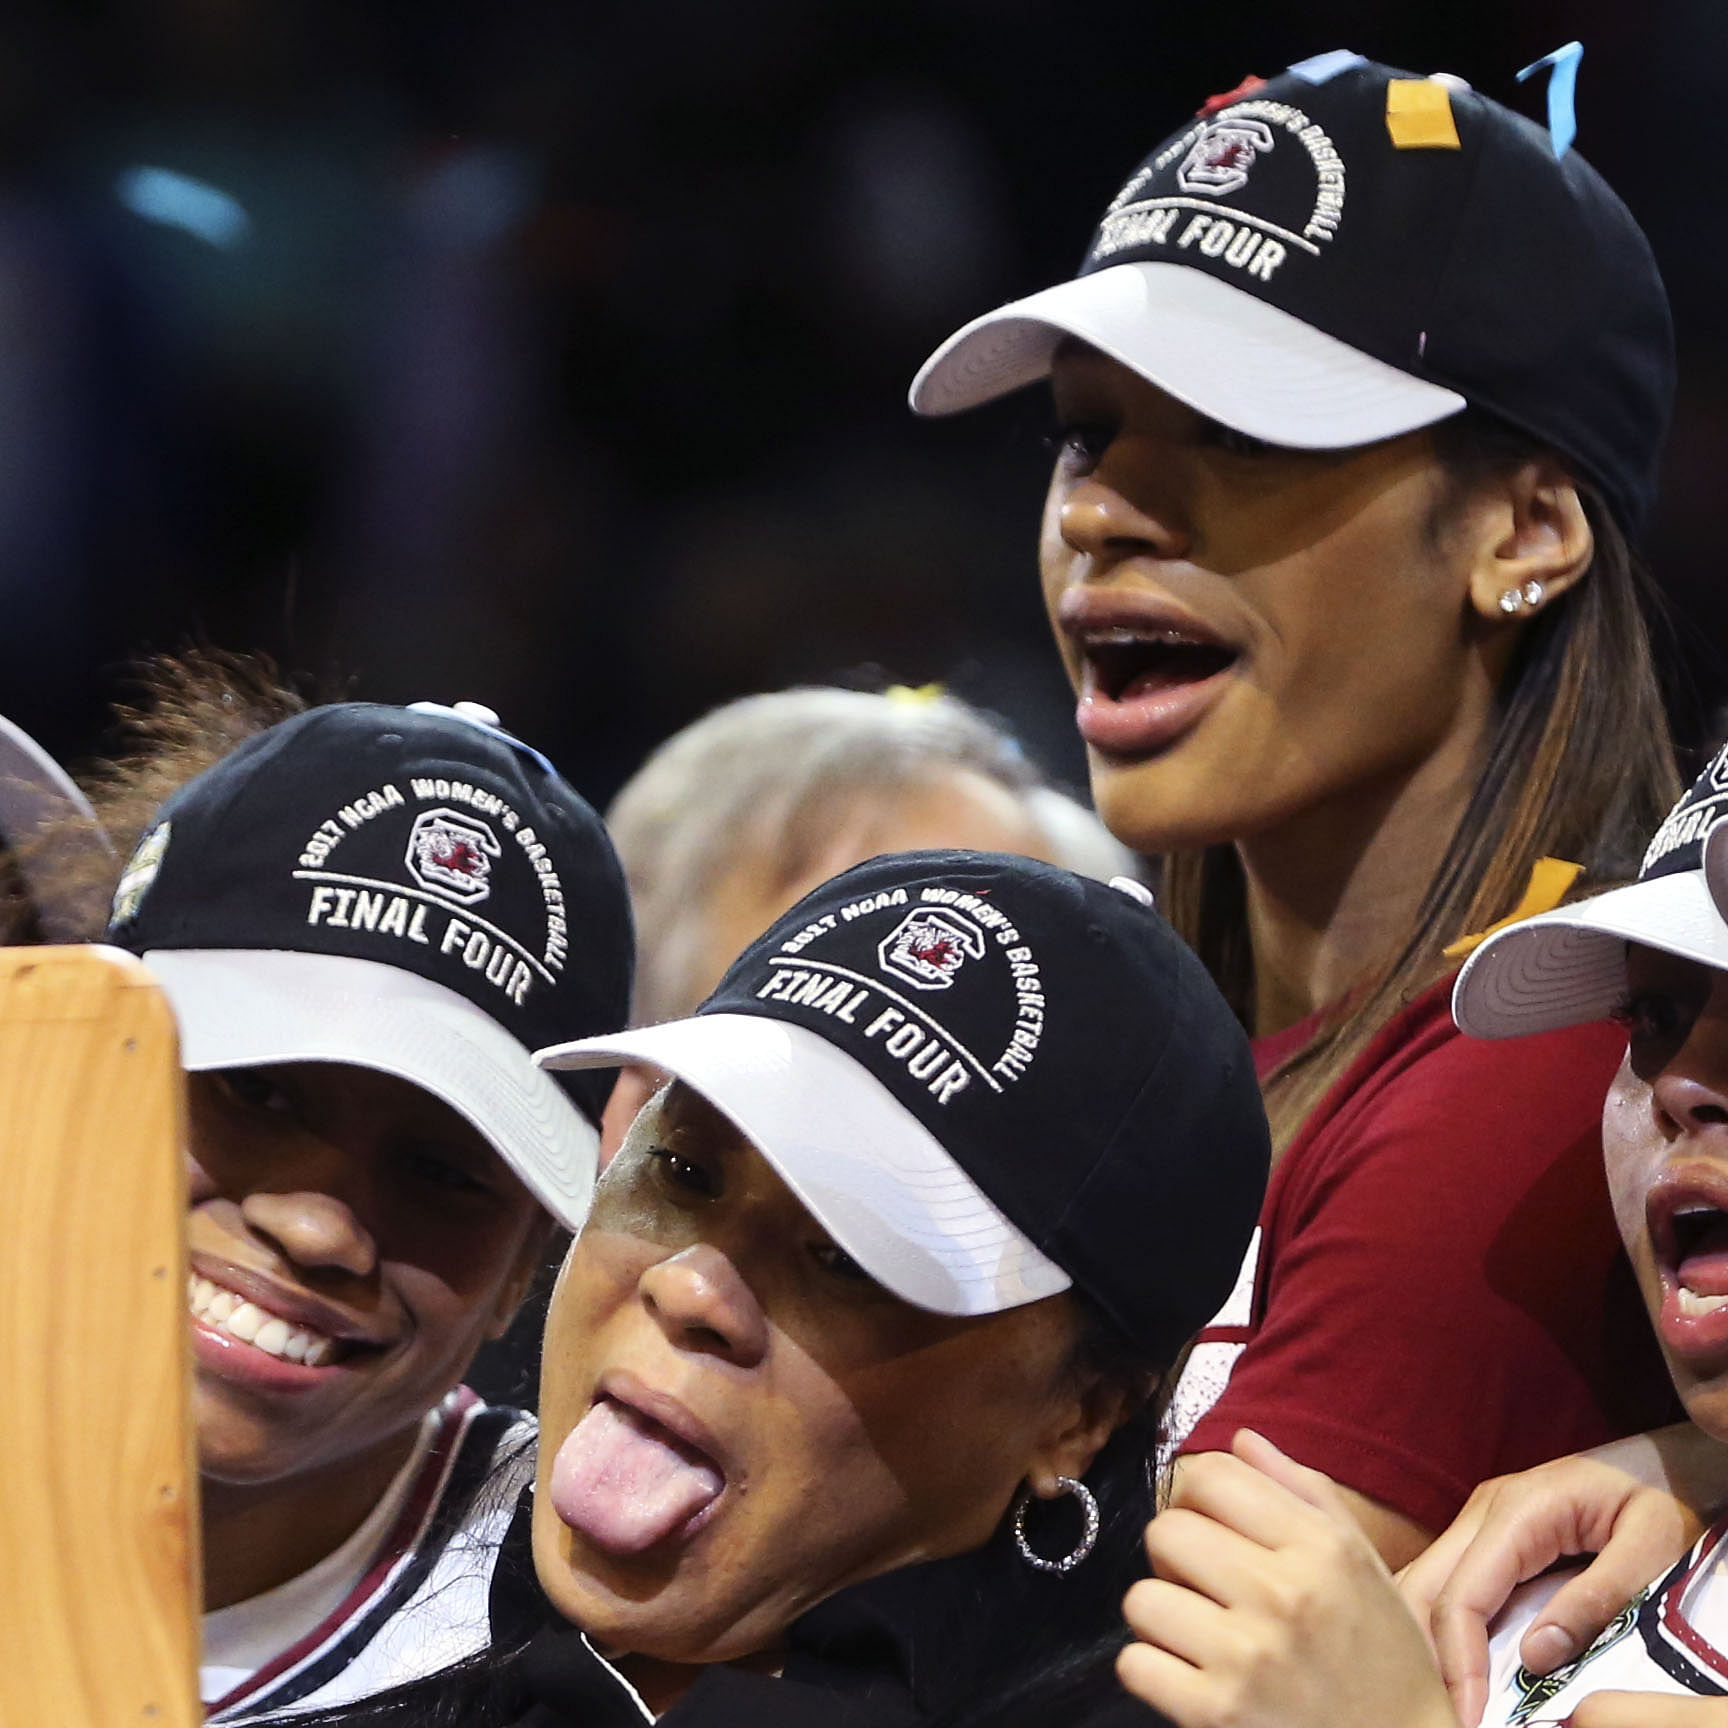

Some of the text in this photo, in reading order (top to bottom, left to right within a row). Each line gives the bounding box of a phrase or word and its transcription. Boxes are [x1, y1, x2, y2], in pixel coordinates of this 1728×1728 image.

[1176, 213, 1288, 282] FOUR
[298, 777, 570, 971] 2017 NCAA WOMEN'S BASKETBALL
[307, 885, 536, 1006] FINAL FOUR
[779, 887, 1046, 1083] 2017 NCAA WOMEN'S BASKETBALL
[755, 968, 973, 1106] FINAL FOUR
